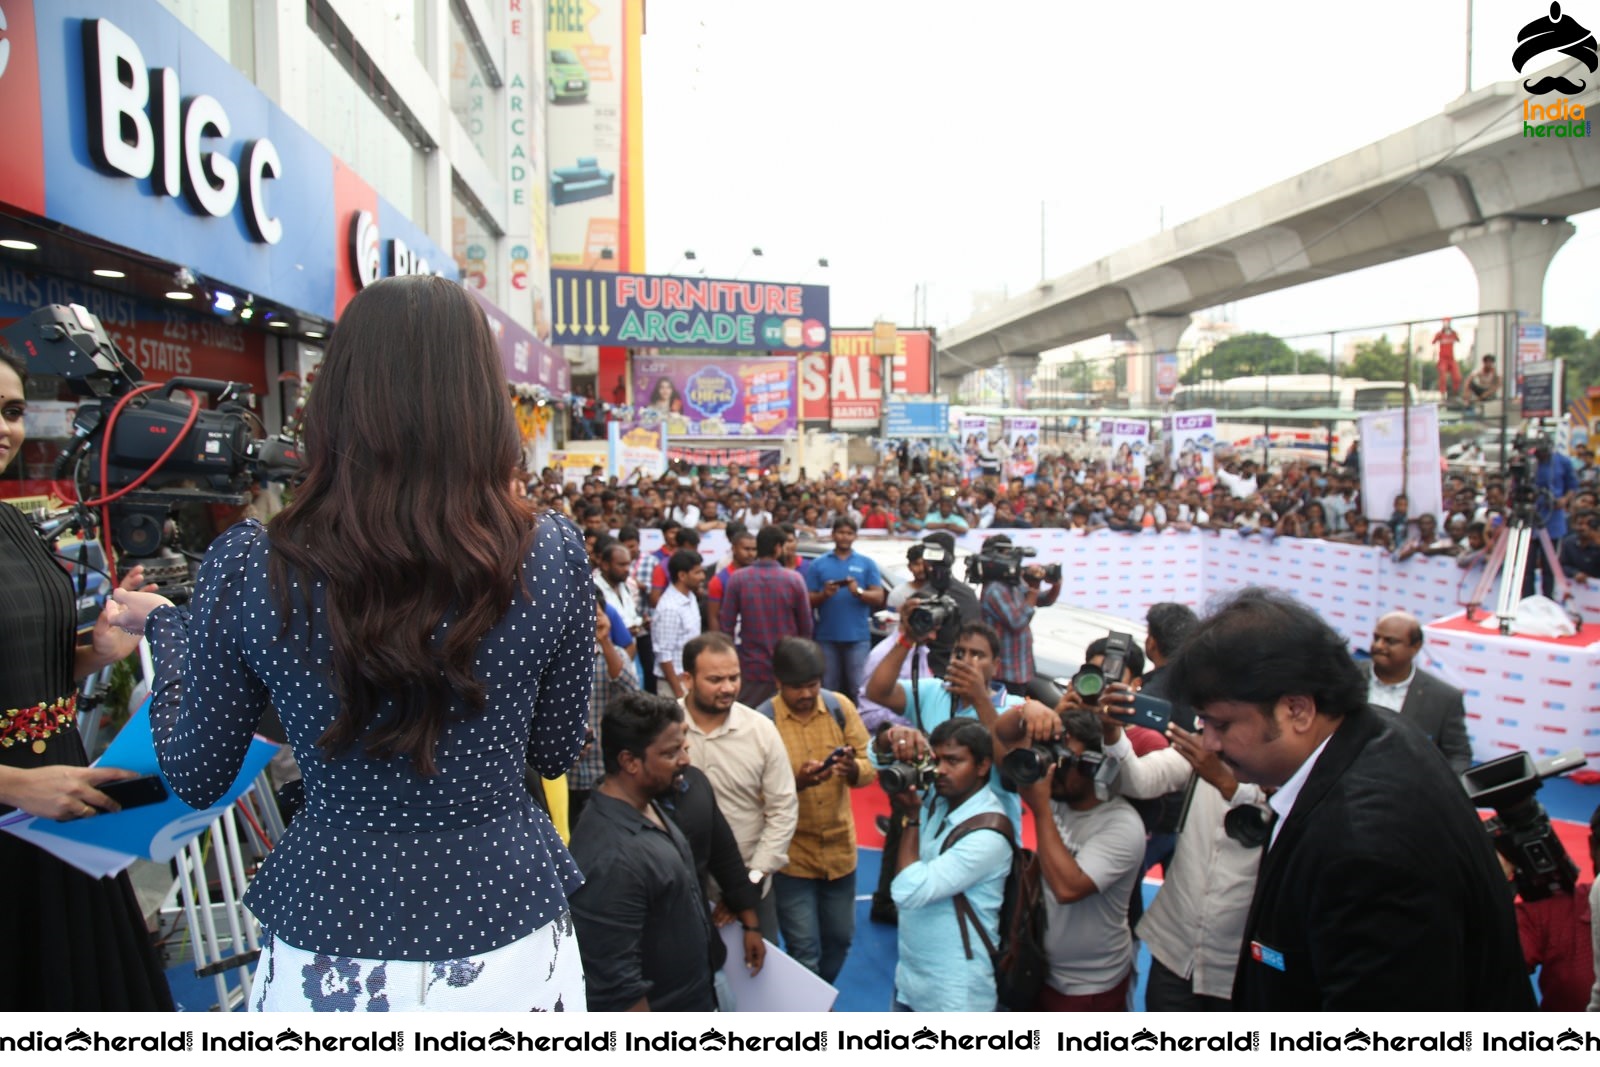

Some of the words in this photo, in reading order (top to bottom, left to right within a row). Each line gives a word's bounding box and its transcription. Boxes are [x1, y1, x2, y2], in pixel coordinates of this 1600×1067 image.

[97, 17, 239, 218] BIG
[248, 138, 282, 245] C
[510, 74, 525, 205] ARCADE
[615, 276, 804, 316] FURNITURE
[618, 309, 756, 344] ARCADE
[139, 337, 193, 375] STATES
[802, 355, 907, 401] SALE
